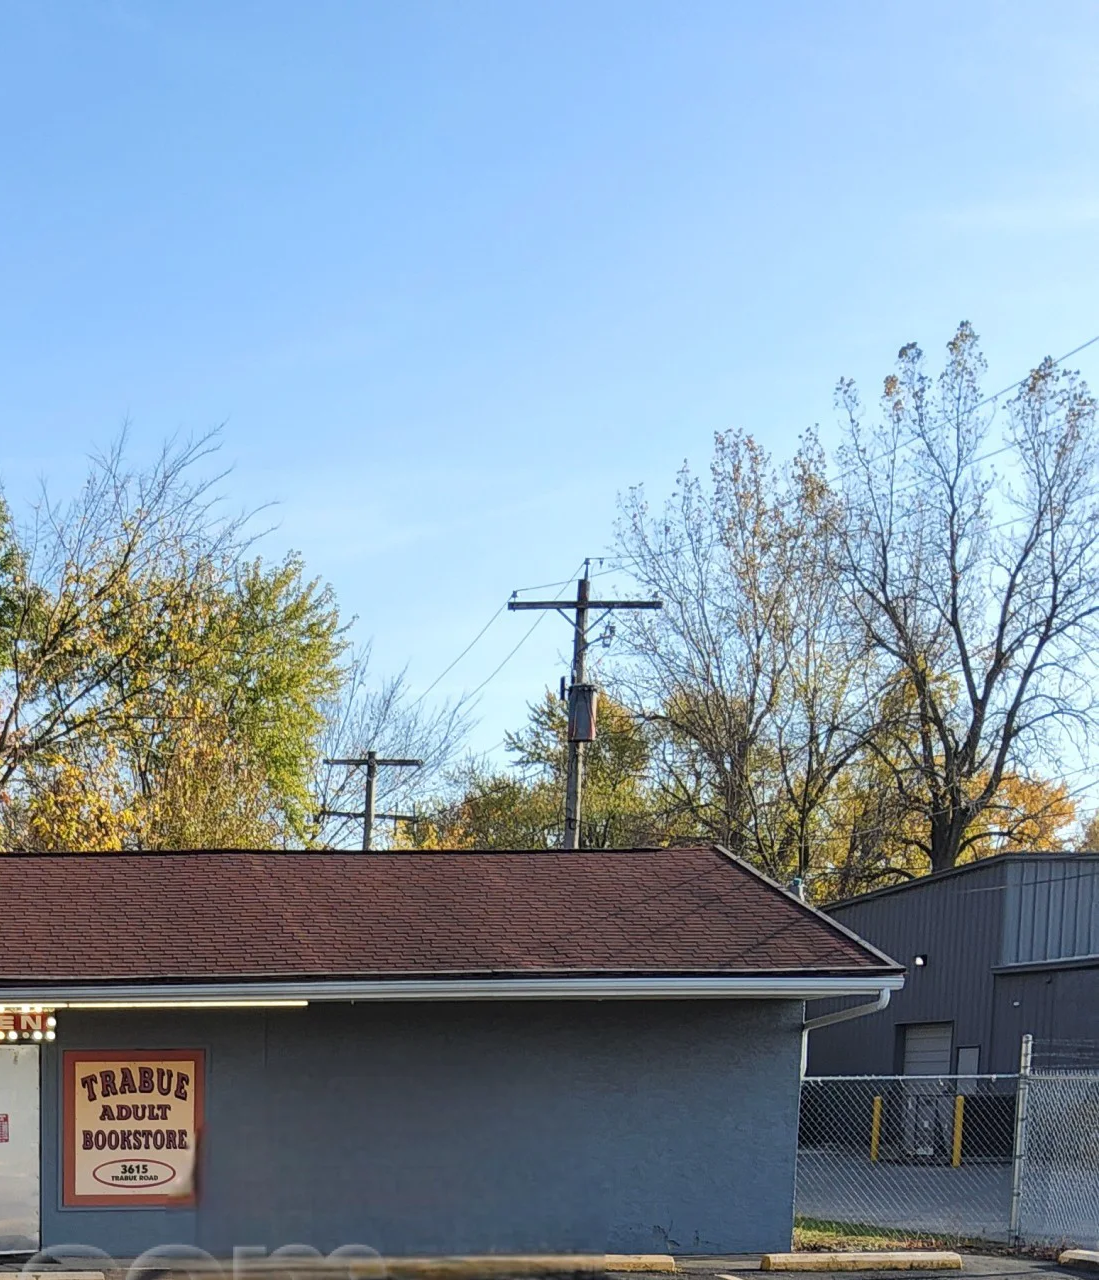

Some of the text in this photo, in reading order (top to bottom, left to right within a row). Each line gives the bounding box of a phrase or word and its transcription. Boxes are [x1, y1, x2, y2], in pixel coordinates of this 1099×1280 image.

[81, 1066, 190, 1102] TRABUE
[99, 1104, 172, 1121] ADULT
[82, 1129, 189, 1151] BOOKSTORE
[120, 1164, 149, 1175] 3615
